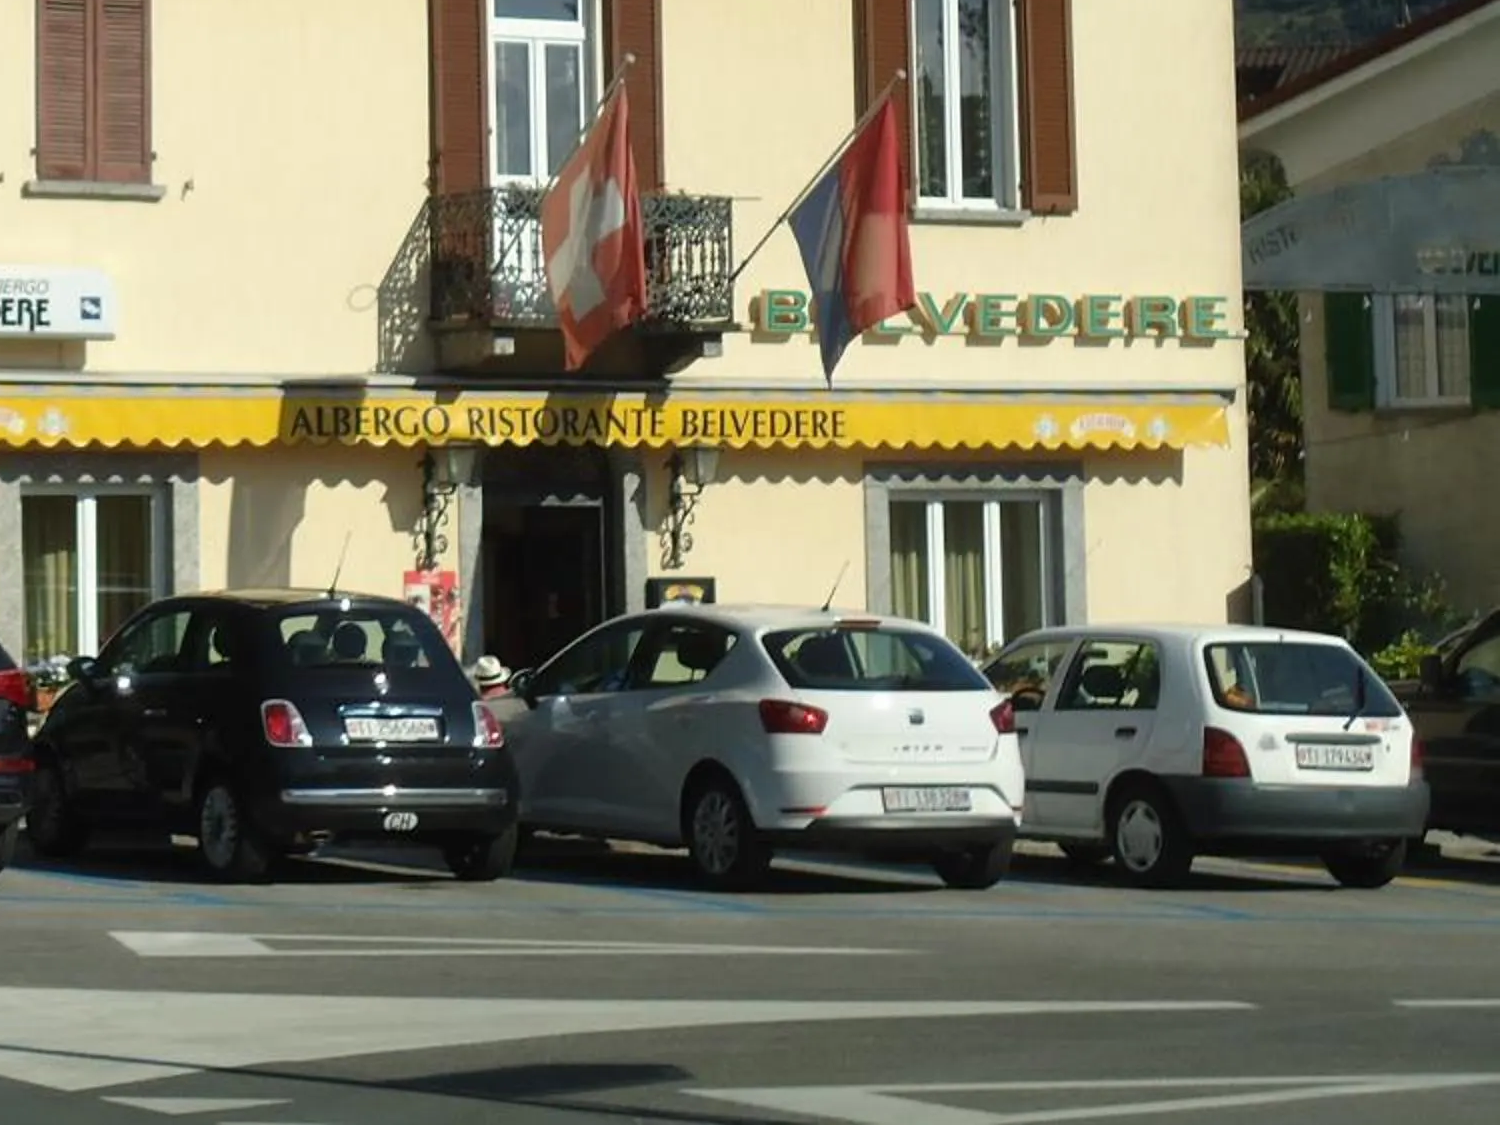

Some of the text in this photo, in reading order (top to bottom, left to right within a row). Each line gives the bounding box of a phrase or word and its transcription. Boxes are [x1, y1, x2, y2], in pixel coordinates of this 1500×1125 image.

[765, 288, 1228, 337] BLVEDERE
[290, 406, 846, 439] ALBERGO RISTORANTE BELVEDERE
[389, 812, 412, 830] CH
